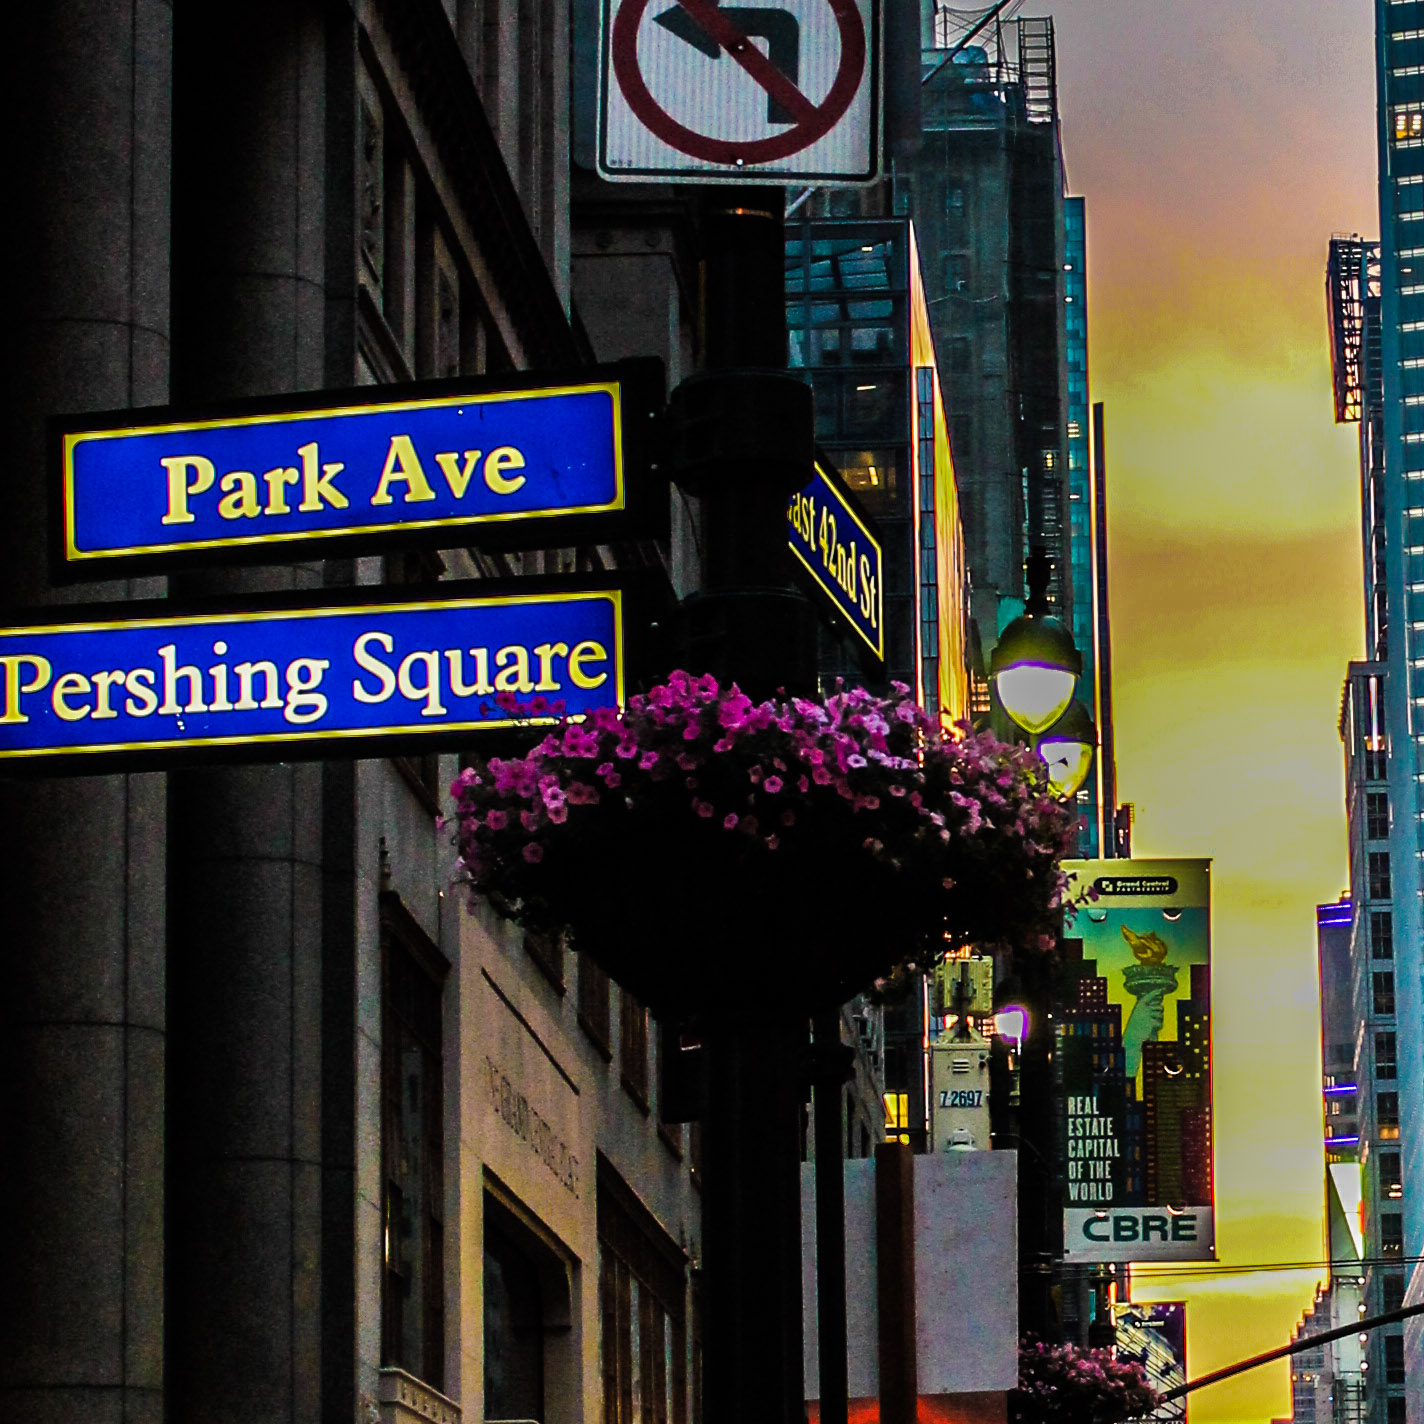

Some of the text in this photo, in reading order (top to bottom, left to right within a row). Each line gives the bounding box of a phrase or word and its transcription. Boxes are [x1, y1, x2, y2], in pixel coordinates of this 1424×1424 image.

[160, 433, 526, 526] Park Ave
[819, 505, 857, 603] 42nd
[860, 553, 877, 629] St
[0, 631, 608, 724] Pershing Square
[1116, 880, 1170, 888] Grand Central
[940, 1090, 982, 1108] 7-2697
[1067, 1096, 1100, 1115] REAL
[1067, 1117, 1114, 1137] ESTATE
[1067, 1138, 1121, 1159] CAPITAL
[1068, 1160, 1112, 1180] OF THE
[1068, 1182, 1114, 1201] WORLD
[1082, 1215, 1198, 1242] CBRE
